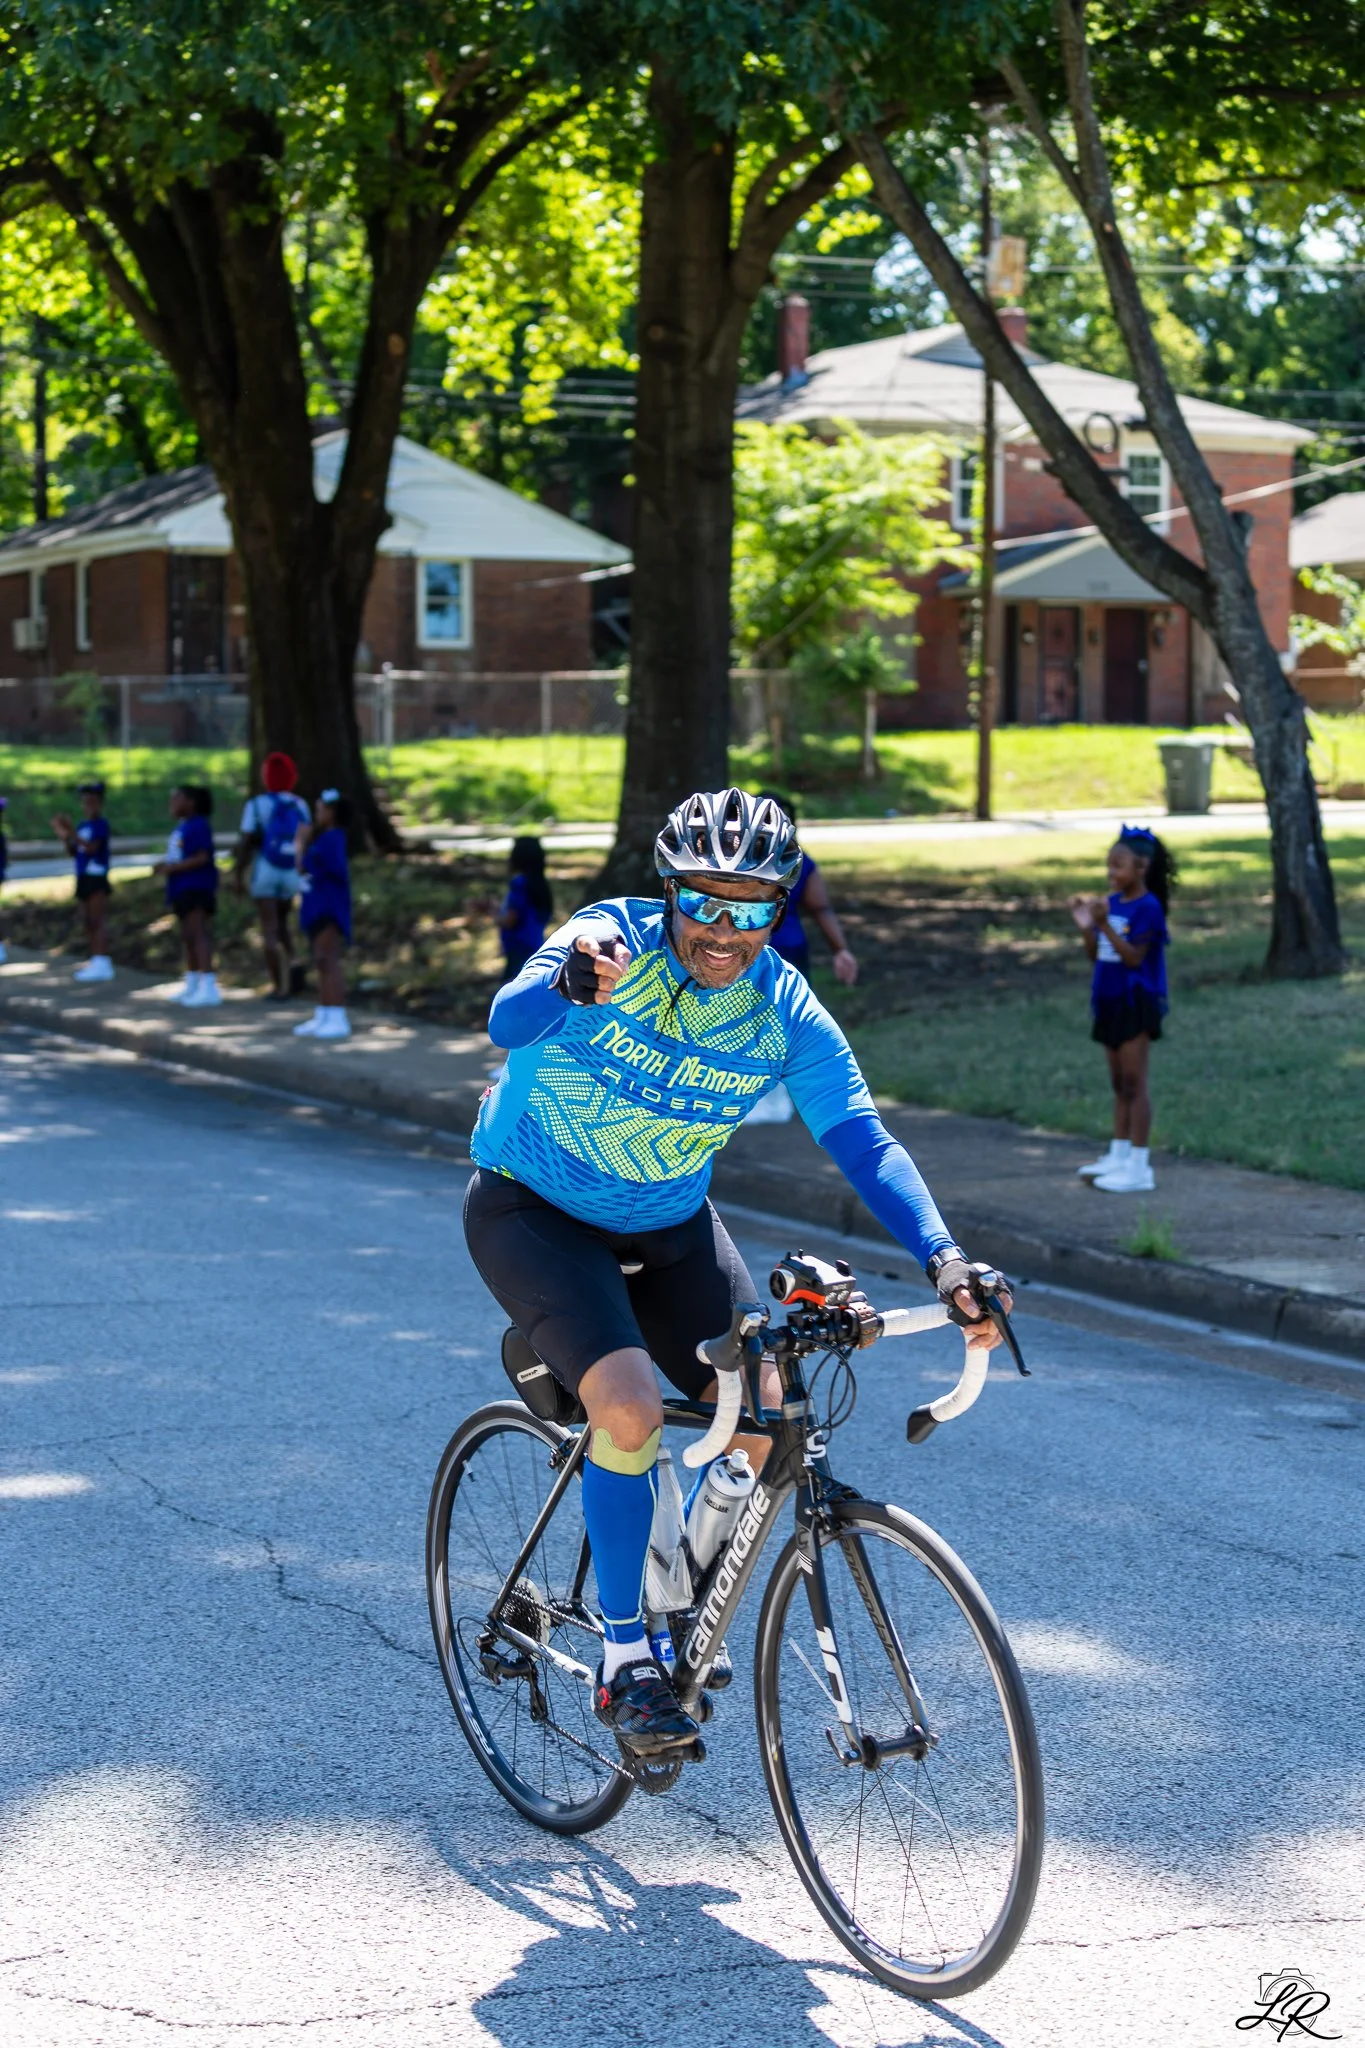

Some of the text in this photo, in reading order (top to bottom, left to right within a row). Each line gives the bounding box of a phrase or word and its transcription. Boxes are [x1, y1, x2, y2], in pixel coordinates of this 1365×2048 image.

[588, 1019, 671, 1077] NORTH
[601, 1066, 742, 1117] RIDERS
[685, 1486, 771, 1670] cannondale
